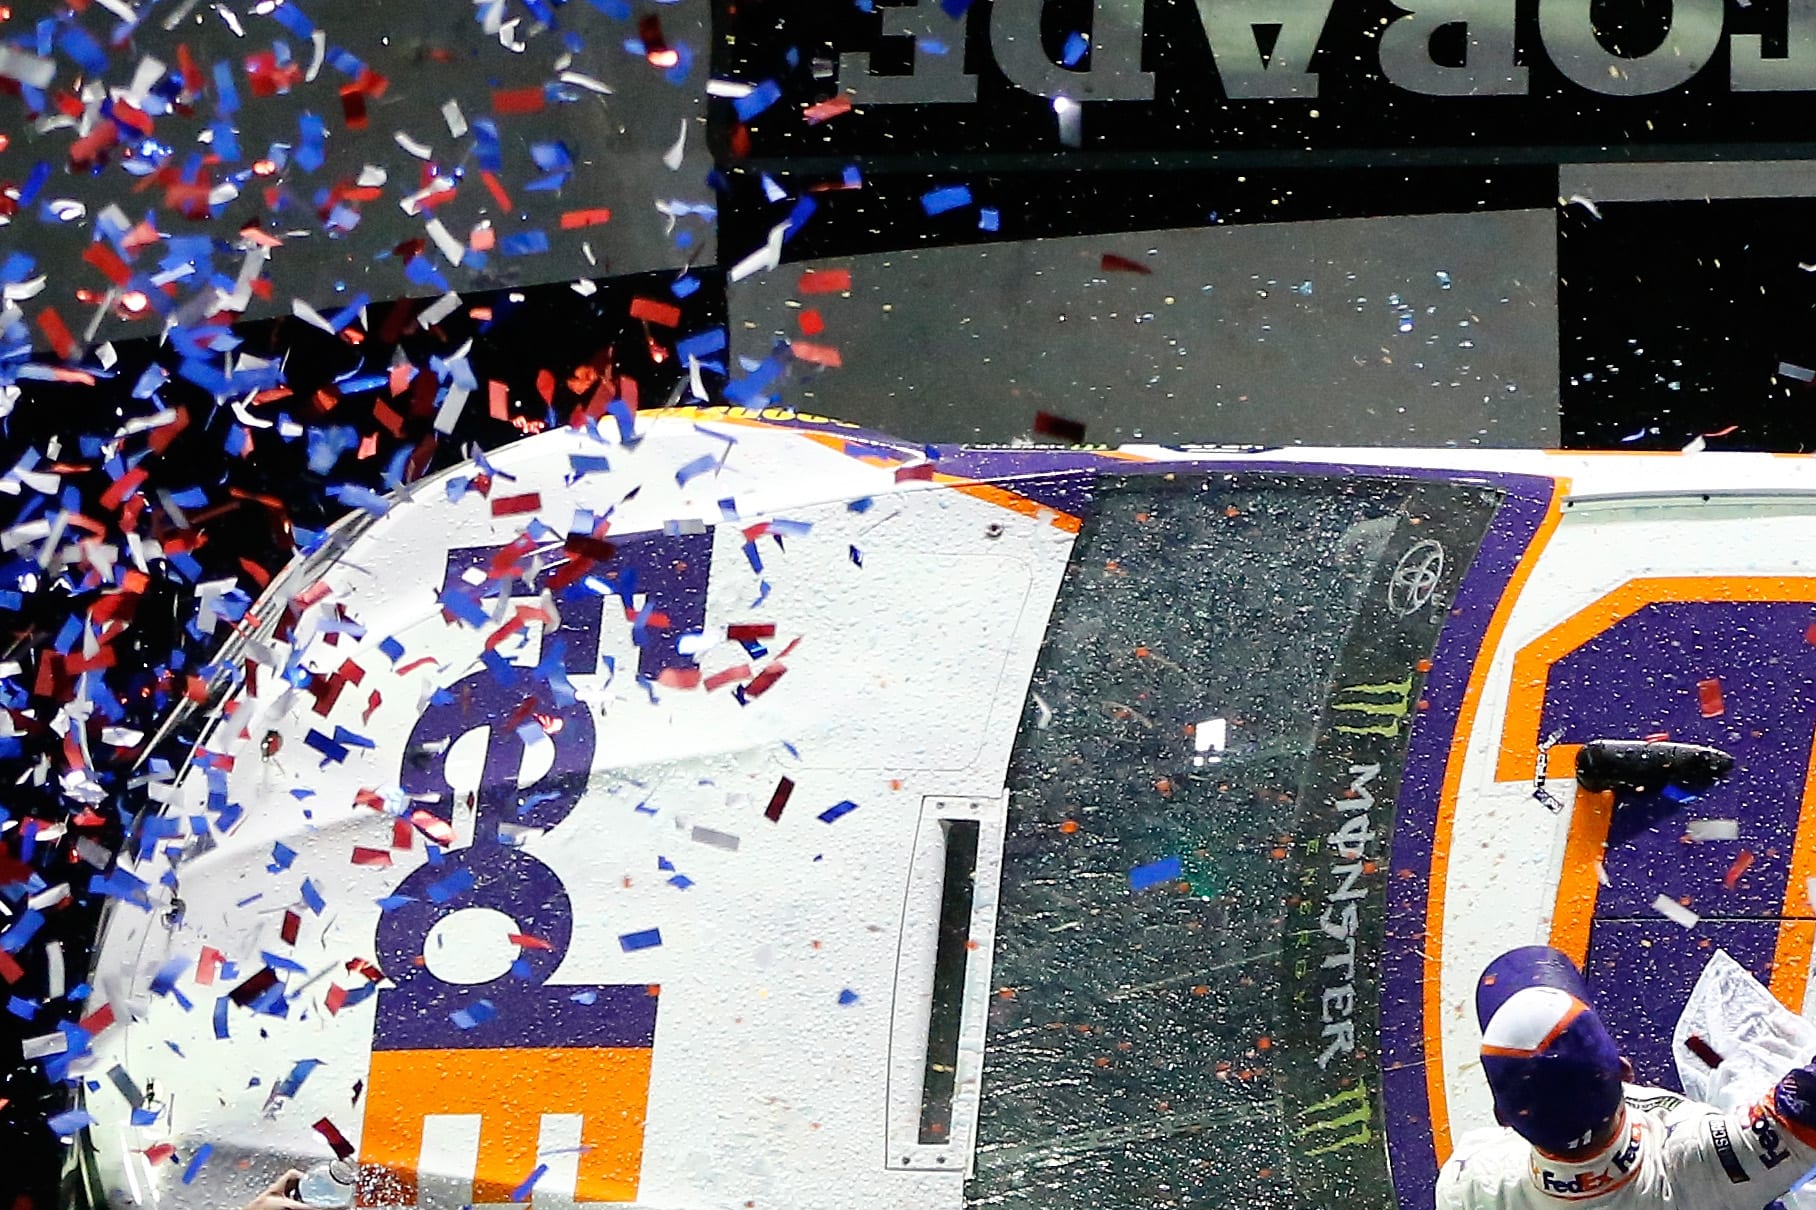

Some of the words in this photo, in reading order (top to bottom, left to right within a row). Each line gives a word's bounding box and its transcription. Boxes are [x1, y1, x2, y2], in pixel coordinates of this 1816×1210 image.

[1318, 762, 1381, 1070] MONSTER
[1567, 1130, 1592, 1149] 11
[1543, 1170, 1612, 1193] FedEx
